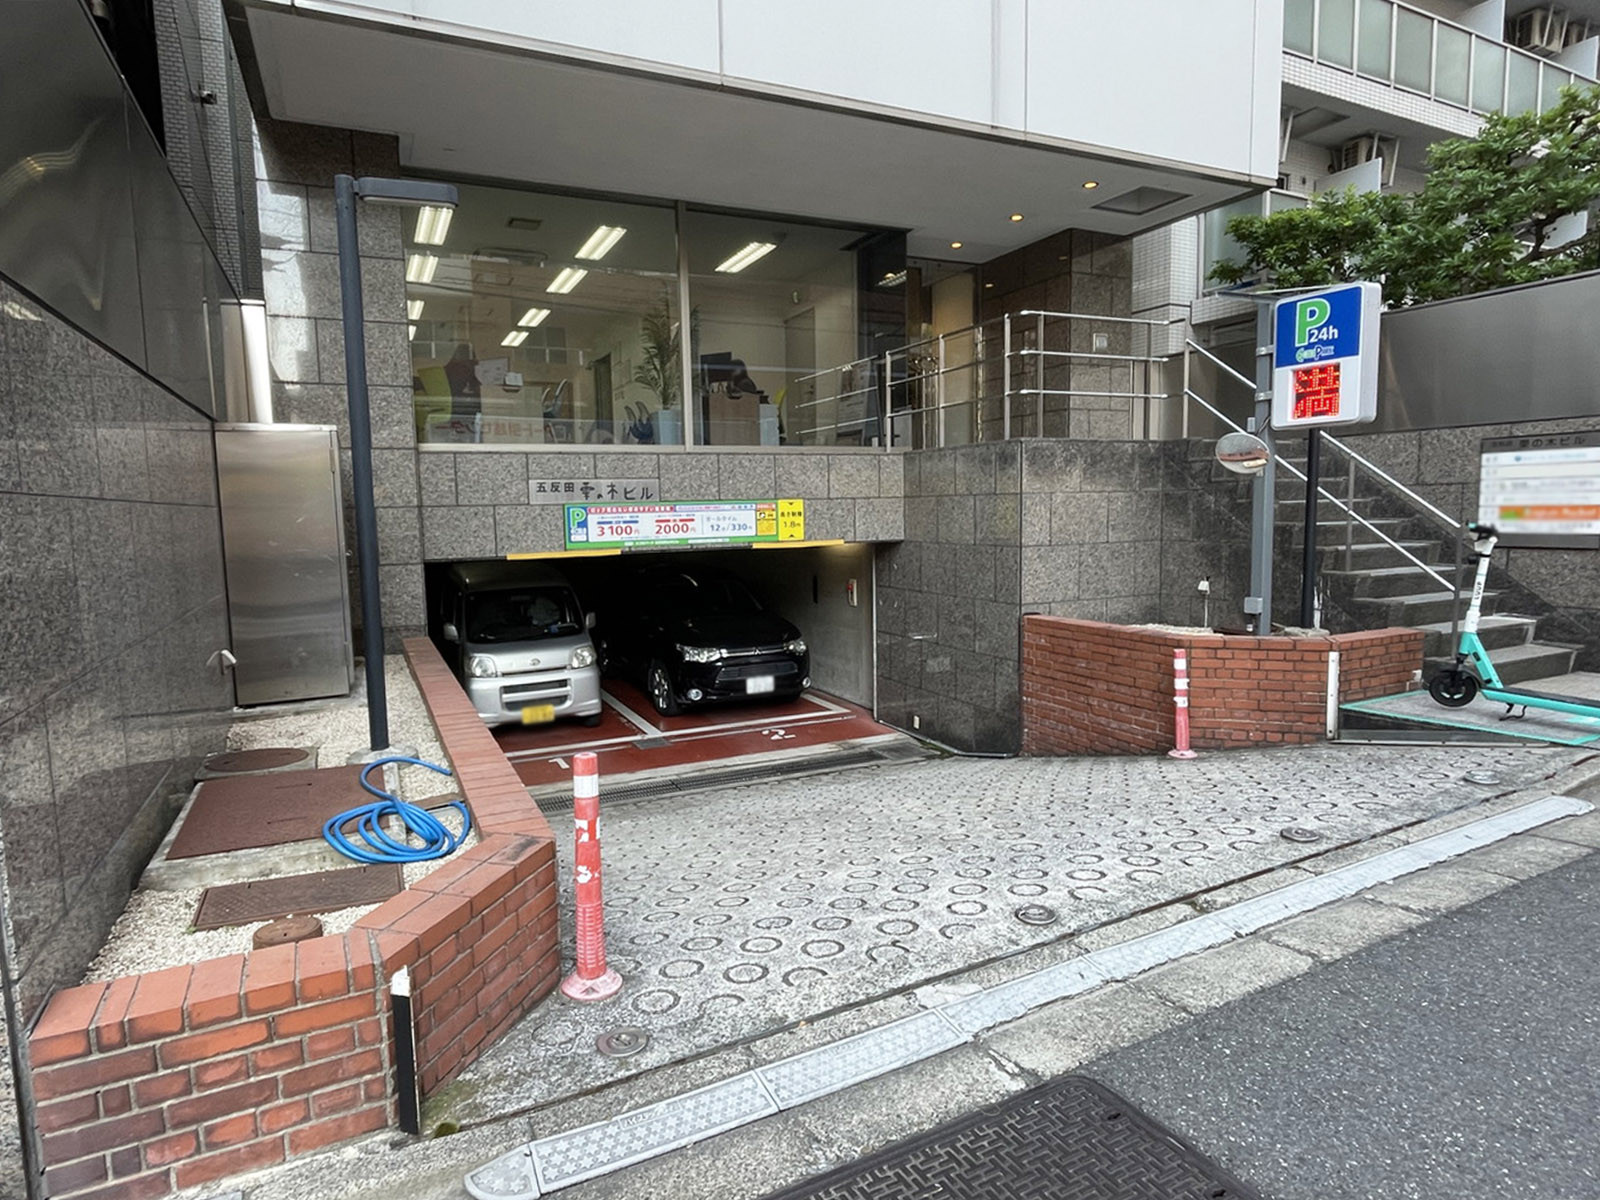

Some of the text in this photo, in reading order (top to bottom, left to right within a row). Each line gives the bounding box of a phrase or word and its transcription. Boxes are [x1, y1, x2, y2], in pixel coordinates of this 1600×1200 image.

[1296, 298, 1330, 346] P
[1310, 325, 1339, 343] 24h
[570, 507, 586, 529] P
[762, 729, 797, 741] 2
[548, 757, 571, 770] 1
